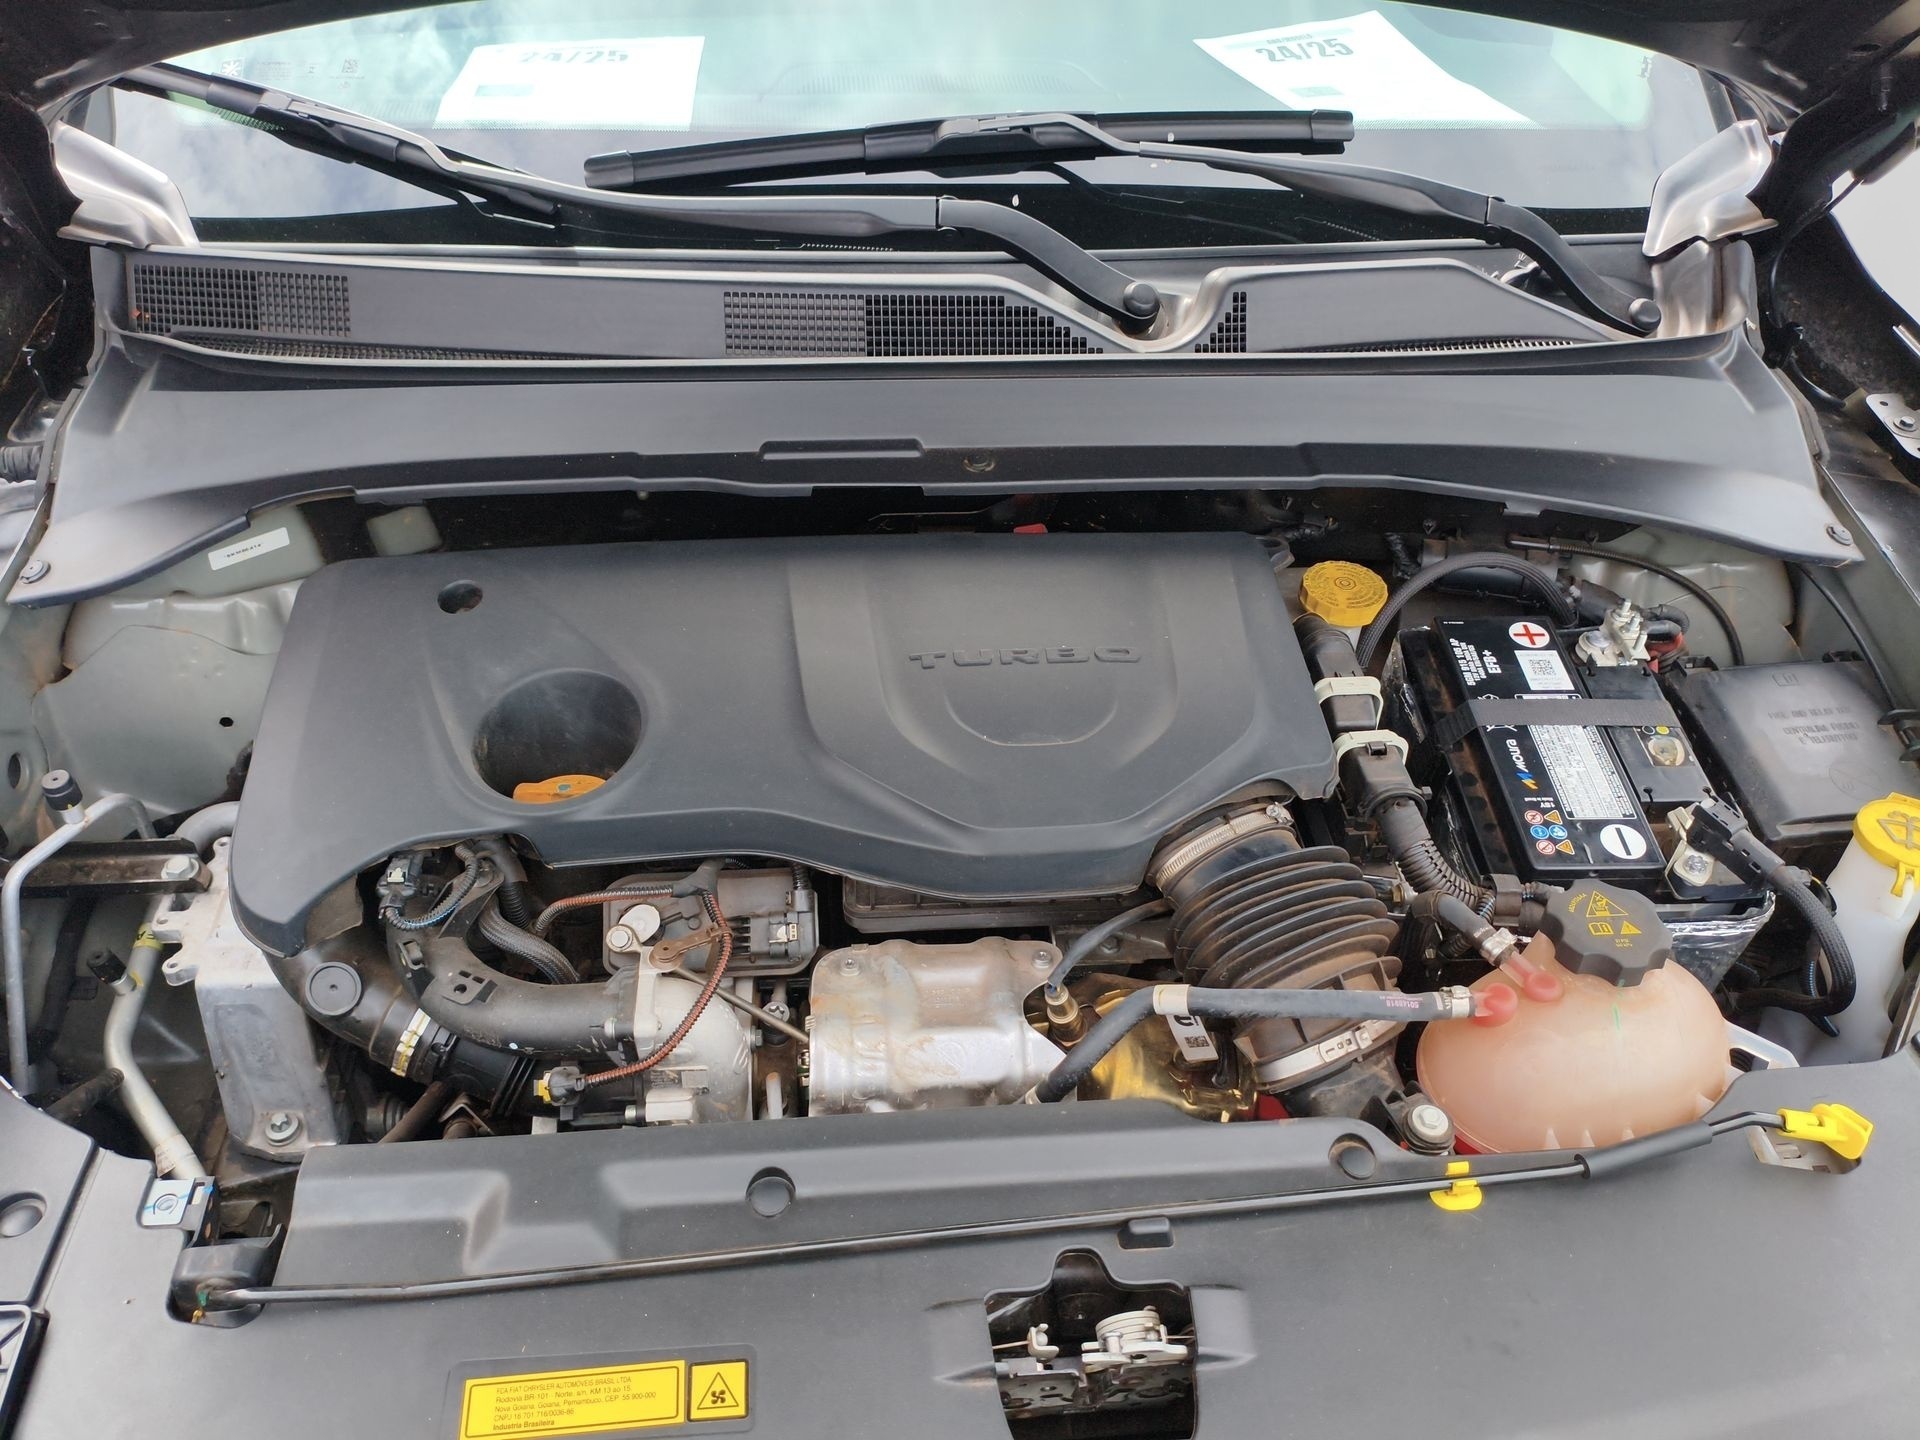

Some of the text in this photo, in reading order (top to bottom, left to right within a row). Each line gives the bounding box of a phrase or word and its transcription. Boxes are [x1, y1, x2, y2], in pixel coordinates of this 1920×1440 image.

[1255, 38, 1354, 62] 24/25
[909, 647, 1141, 669] TURBO
[1482, 649, 1502, 674] EFB+
[509, 1385, 522, 1393] FIAT
[523, 1383, 555, 1392] CHRYSLER
[494, 1405, 511, 1413] Nova
[523, 1420, 555, 1428] Brasileira
